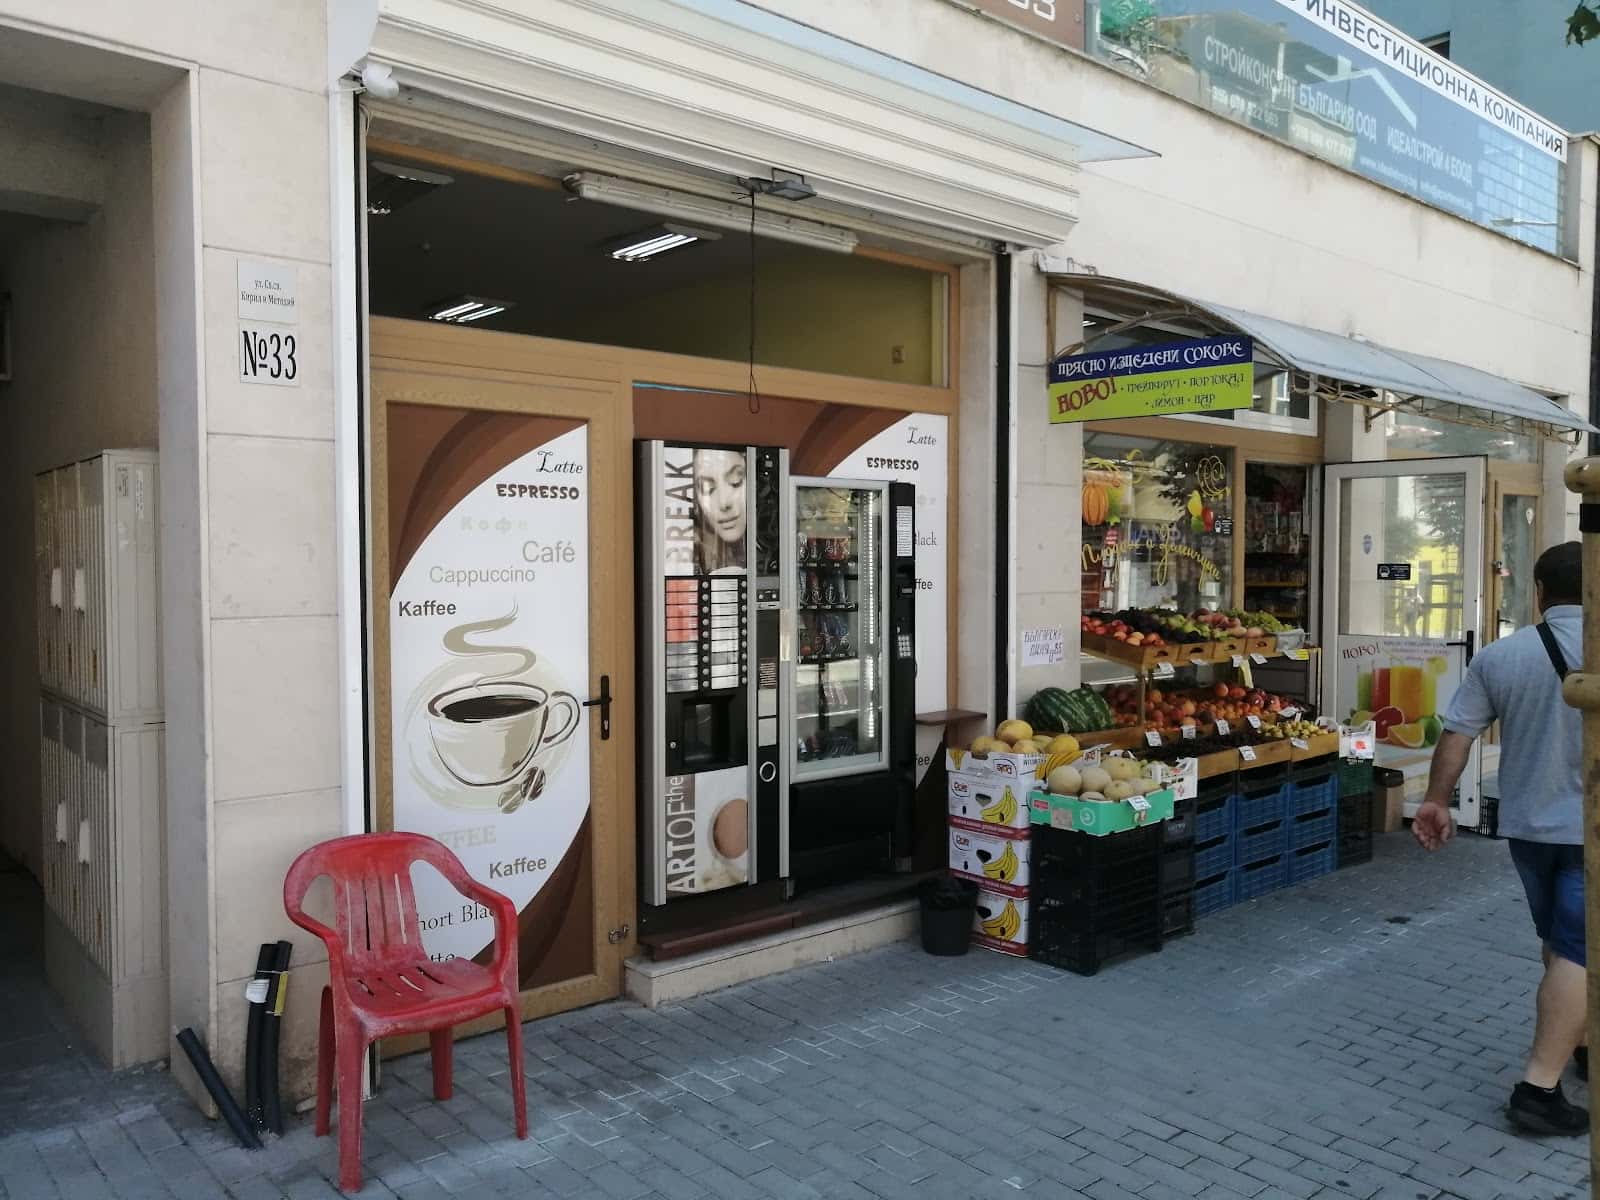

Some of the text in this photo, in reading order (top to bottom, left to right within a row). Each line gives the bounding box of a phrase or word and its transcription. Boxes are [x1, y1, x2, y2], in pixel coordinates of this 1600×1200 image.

[1204, 35, 1298, 104] СТРОЙКОНСЛТ
[1300, 84, 1354, 133] БЪЛГАРИЯ
[1355, 110, 1377, 144] ООД
[1484, 94, 1563, 156] КОМПАНИЯ
[1058, 342, 1246, 376] ПРЯСНО ИЗЦЕДЕНИ СОКОВЕ
[1189, 374, 1245, 388] ПОРТОКАЛ
[1056, 373, 1118, 414] НОВО!
[905, 426, 937, 446] Latte
[536, 450, 583, 474] Latte
[866, 457, 919, 471] ESPRESSO
[496, 483, 580, 500] ESPRESSO
[914, 530, 937, 546] lack
[522, 540, 576, 563] Café
[429, 565, 536, 586] Cappuccino
[399, 600, 457, 617] Kaffee
[1342, 643, 1380, 660] НОВО!
[489, 858, 547, 879] Kaffee
[417, 911, 453, 931] hort
